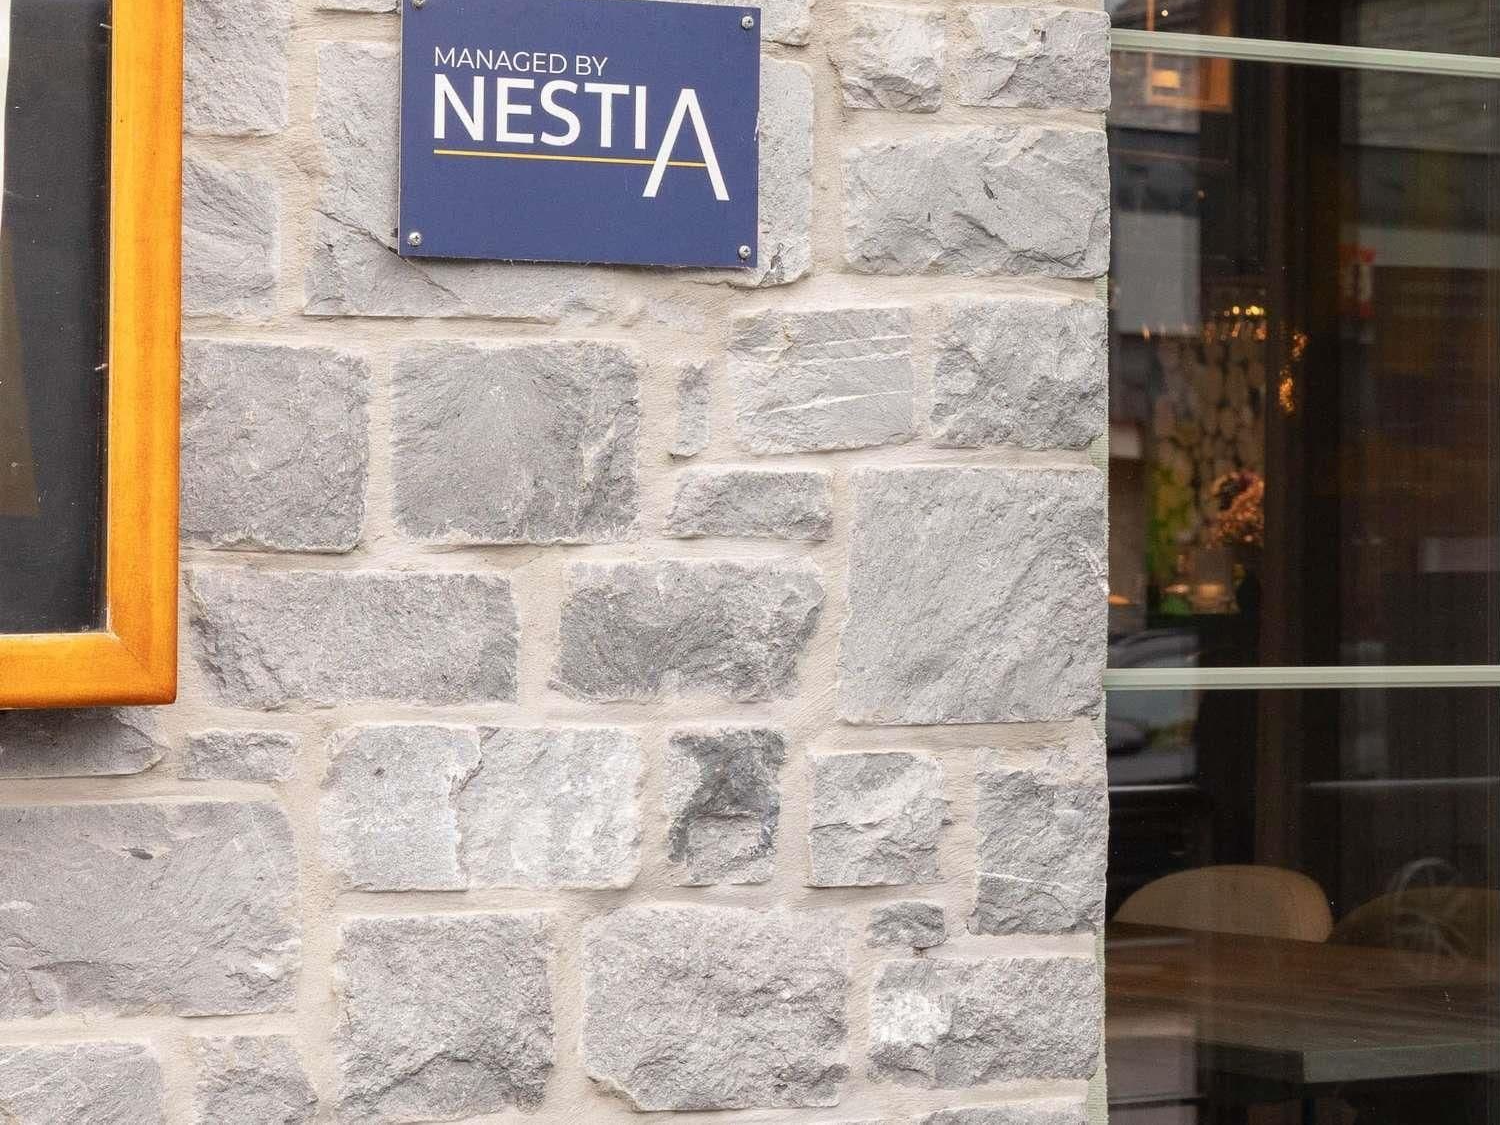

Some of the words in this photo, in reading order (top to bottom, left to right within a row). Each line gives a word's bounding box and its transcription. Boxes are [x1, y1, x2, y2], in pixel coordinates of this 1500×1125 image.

[434, 46, 567, 74] MANAGED
[576, 55, 608, 76] BY
[433, 73, 730, 201] NESTIA
